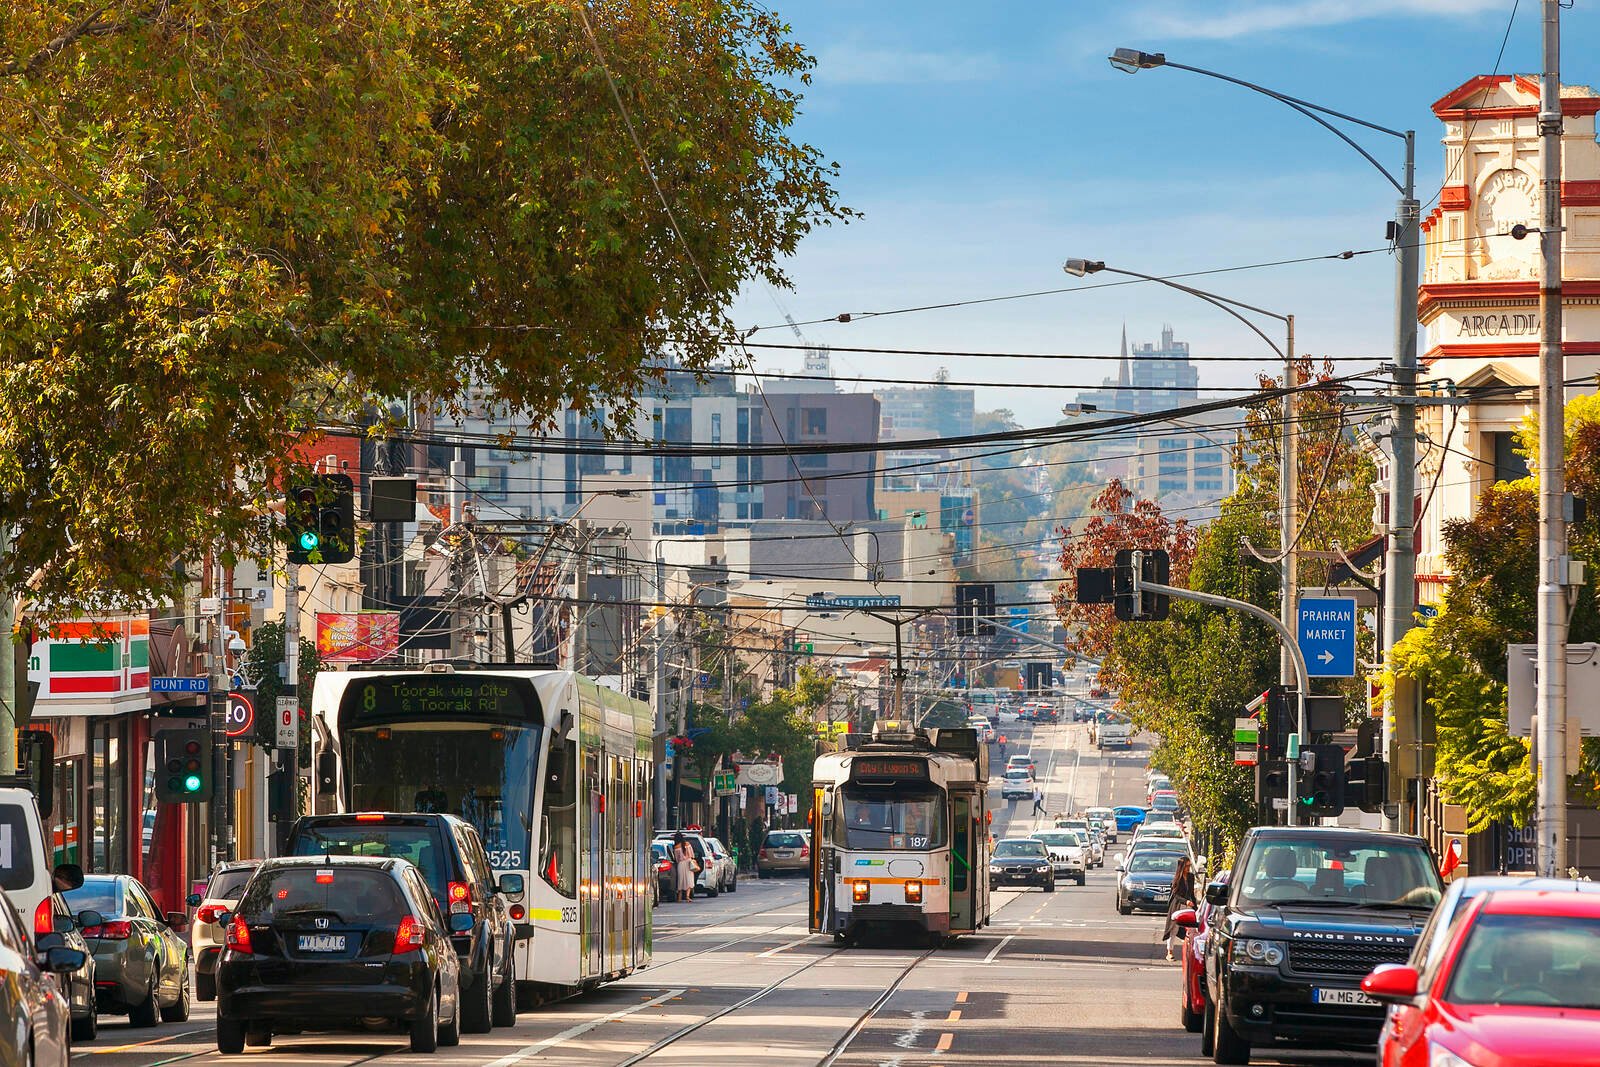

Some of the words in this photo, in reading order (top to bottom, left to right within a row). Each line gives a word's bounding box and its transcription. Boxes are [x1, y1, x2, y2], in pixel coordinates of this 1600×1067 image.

[1302, 610, 1351, 621] PRAHRAN
[1306, 629, 1346, 640] MARKET
[153, 679, 183, 690] PUNT
[189, 680, 205, 690] RD
[363, 685, 376, 711] 8
[392, 685, 443, 697] Toorak
[451, 685, 473, 697] via
[480, 684, 508, 698] City
[419, 699, 472, 711] Toorak
[479, 699, 497, 711] Rd
[283, 711, 291, 725] C
[910, 837, 928, 847] 187
[561, 906, 577, 923] 3525
[1293, 932, 1345, 940] RANGE
[1354, 935, 1405, 943] ROVER
